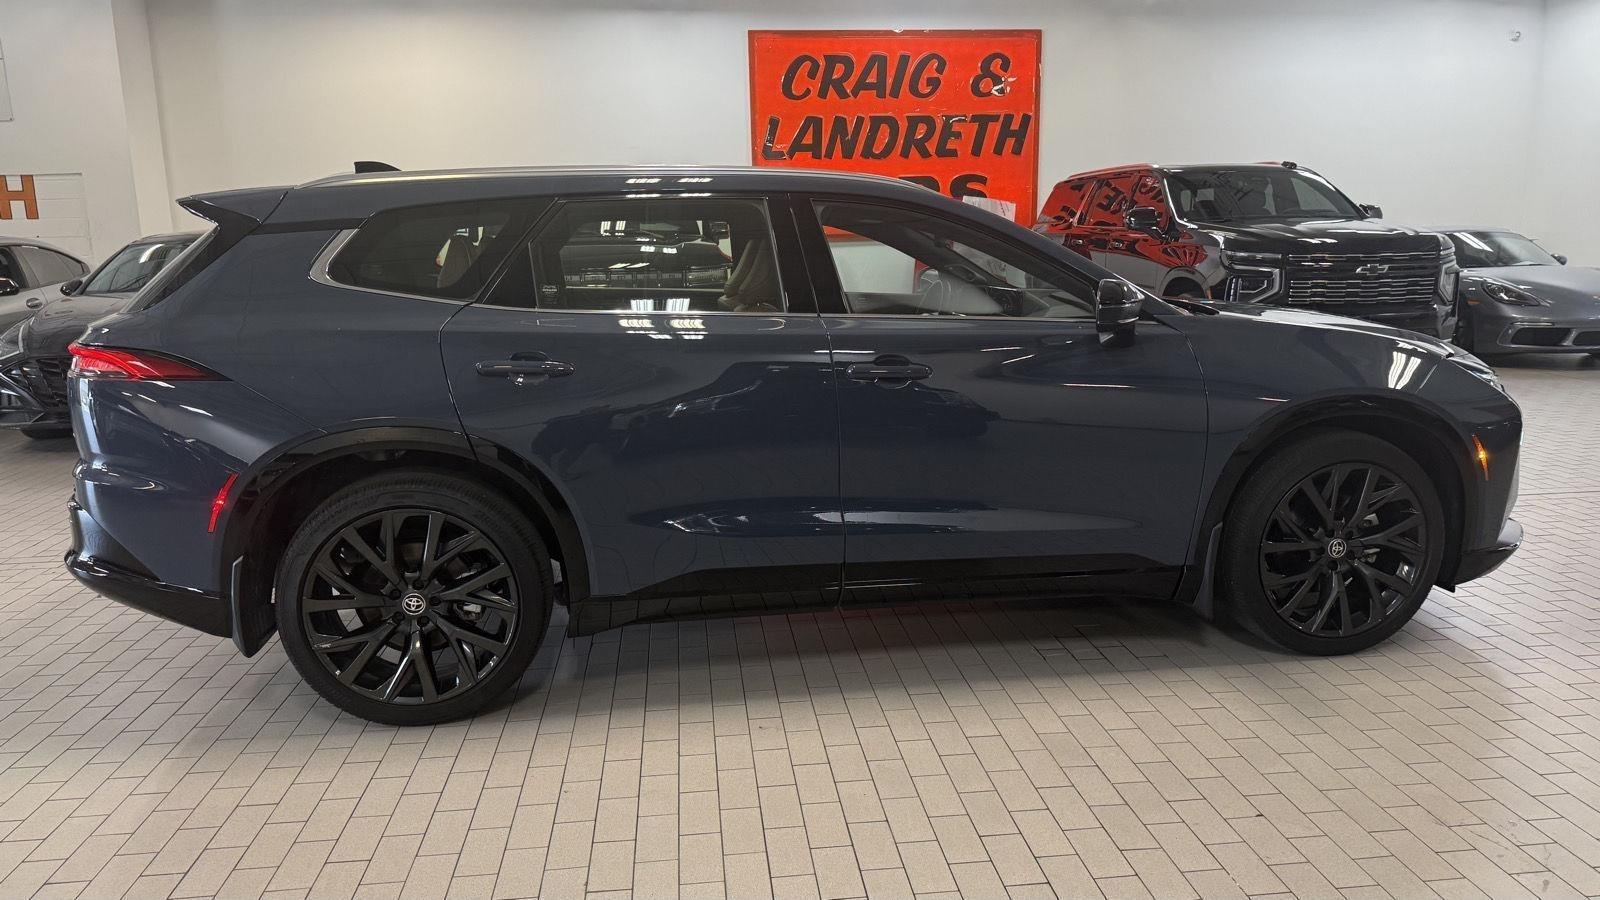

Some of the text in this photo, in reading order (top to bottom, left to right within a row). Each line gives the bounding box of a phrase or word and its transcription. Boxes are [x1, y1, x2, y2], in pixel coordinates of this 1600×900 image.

[782, 53, 1012, 100] CRAIG &
[762, 113, 1032, 160] LANDRETH
